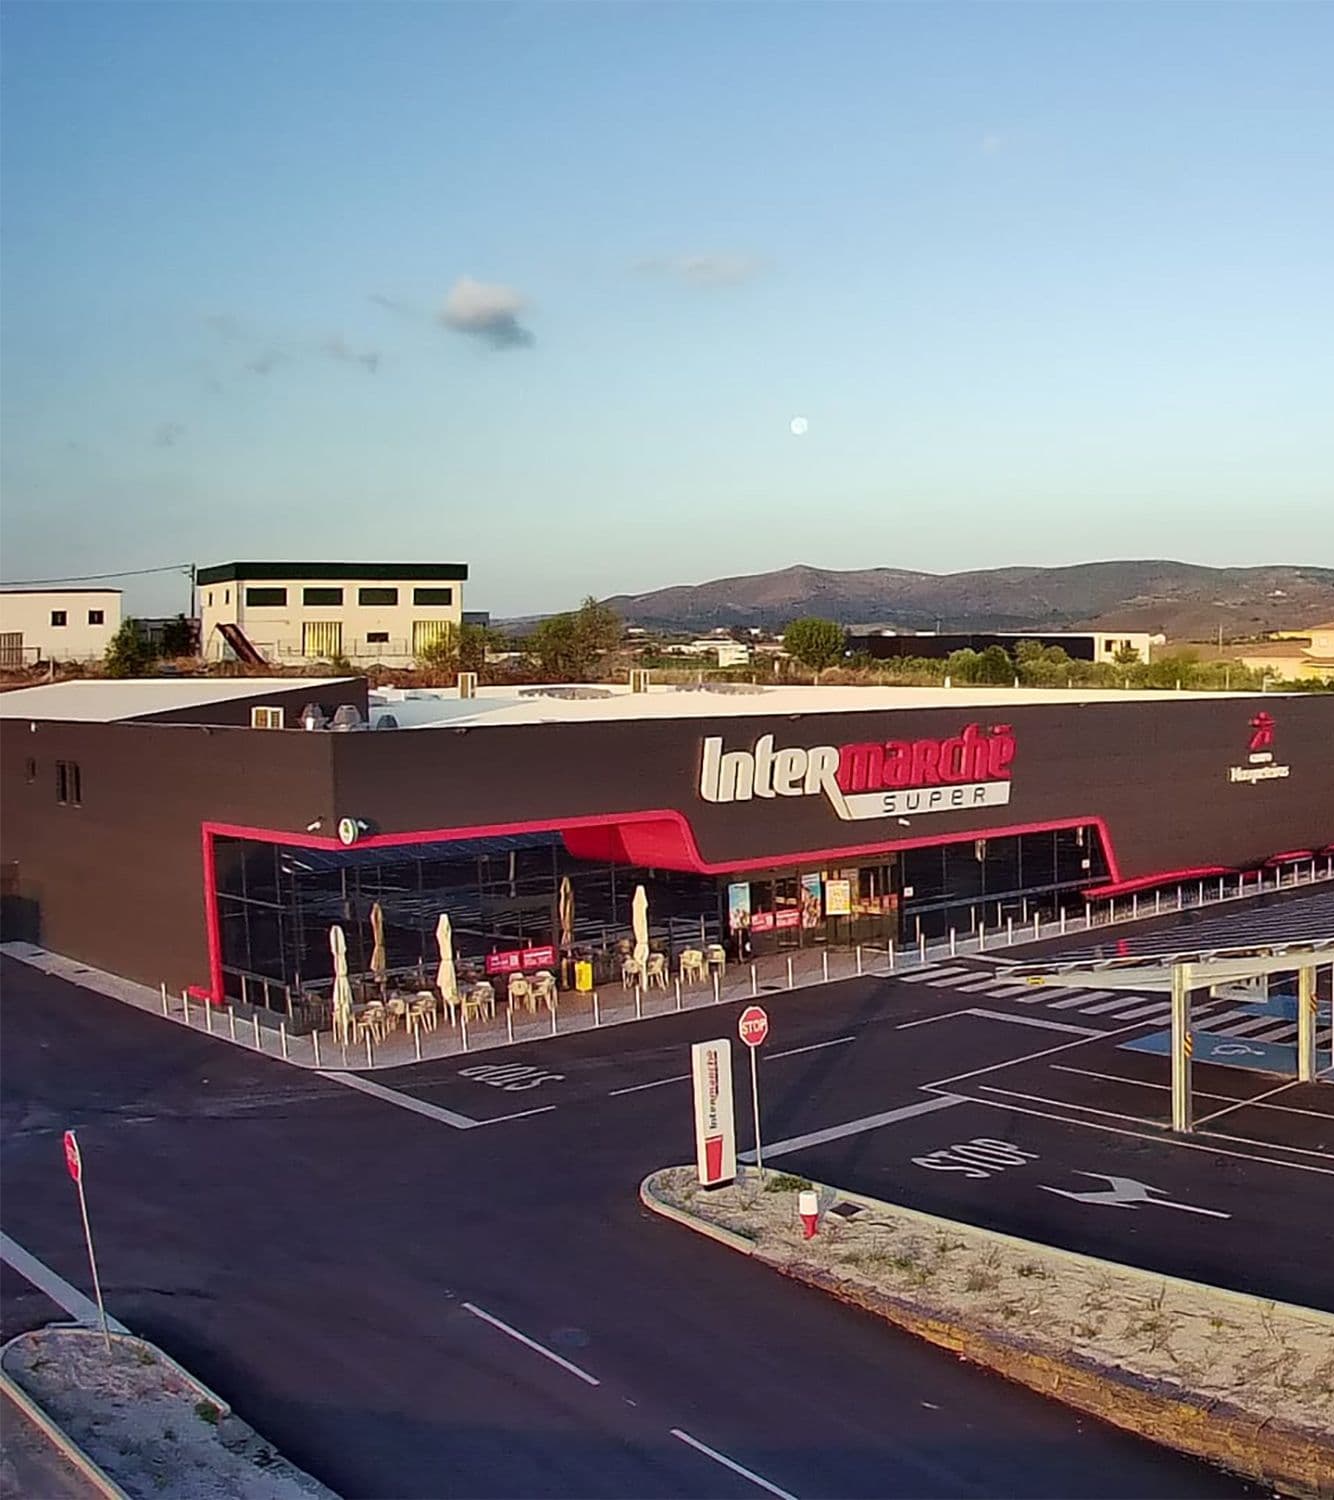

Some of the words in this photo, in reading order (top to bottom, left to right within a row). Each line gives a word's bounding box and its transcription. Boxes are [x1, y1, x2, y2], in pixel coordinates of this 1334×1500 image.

[742, 1018, 766, 1035] STOP
[457, 1062, 565, 1091] STOP
[911, 1137, 1041, 1178] STOP
